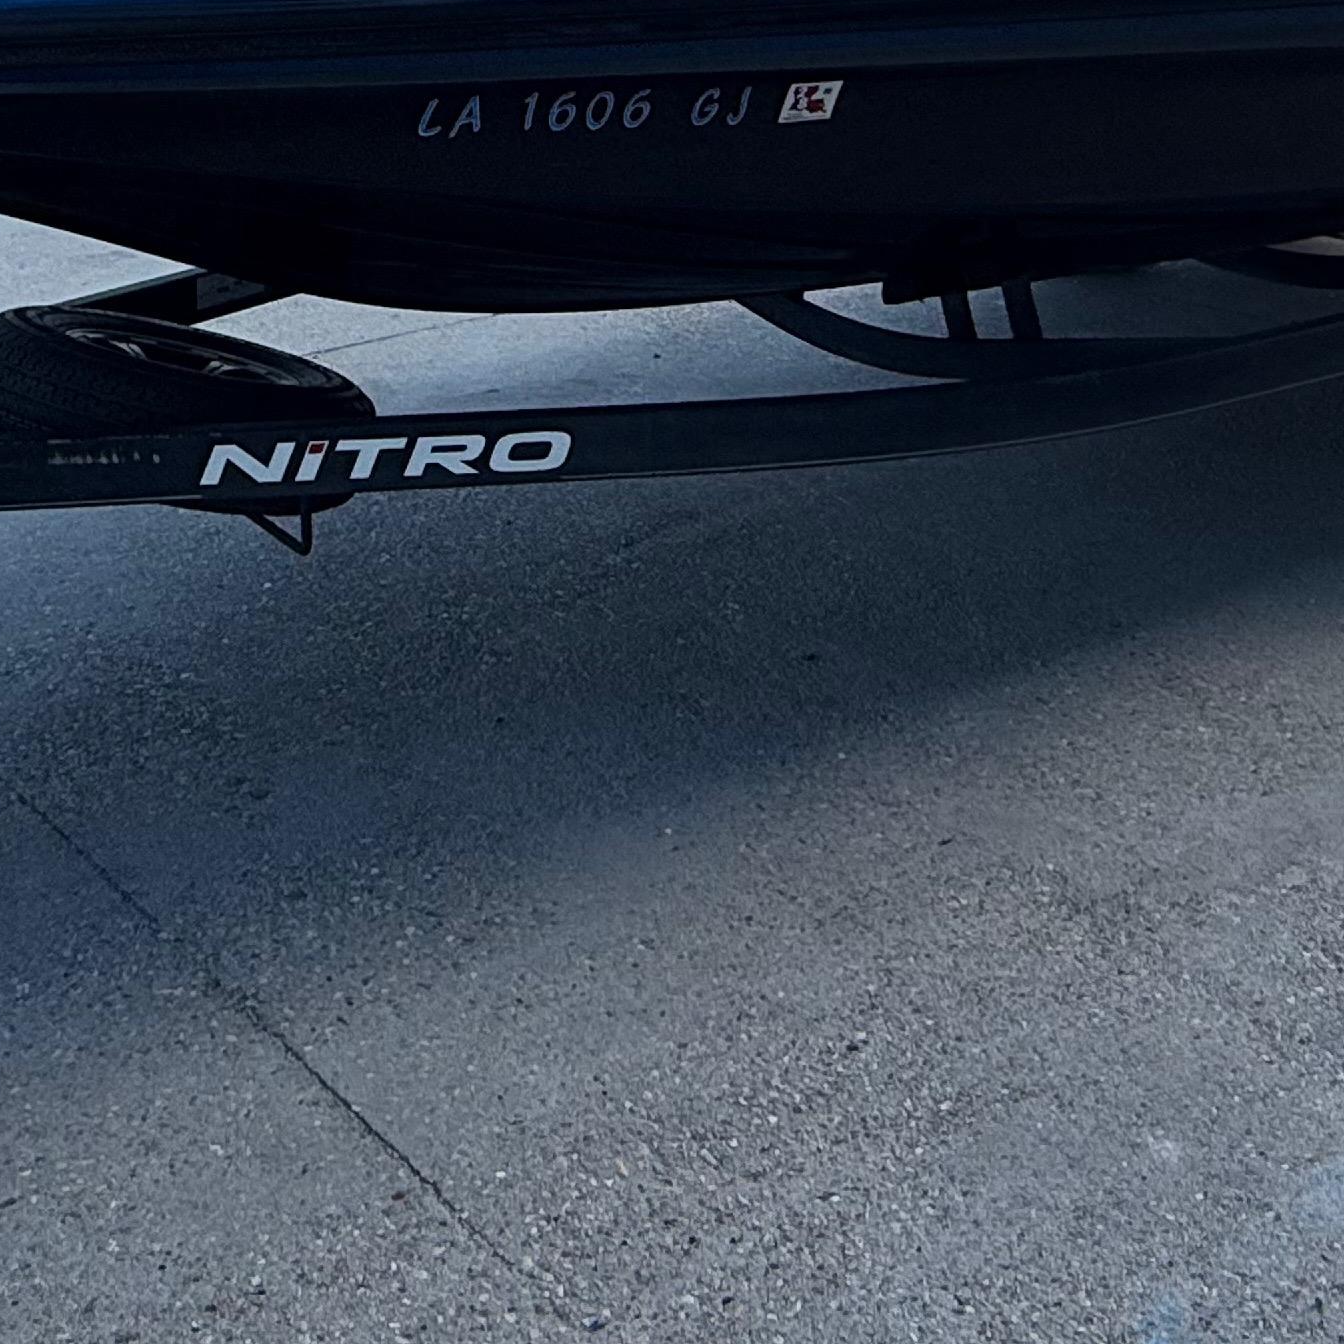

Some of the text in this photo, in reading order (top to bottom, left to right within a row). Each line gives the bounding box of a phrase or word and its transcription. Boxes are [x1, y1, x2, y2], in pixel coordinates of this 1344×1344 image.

[417, 86, 752, 139] LA 1606 GJ
